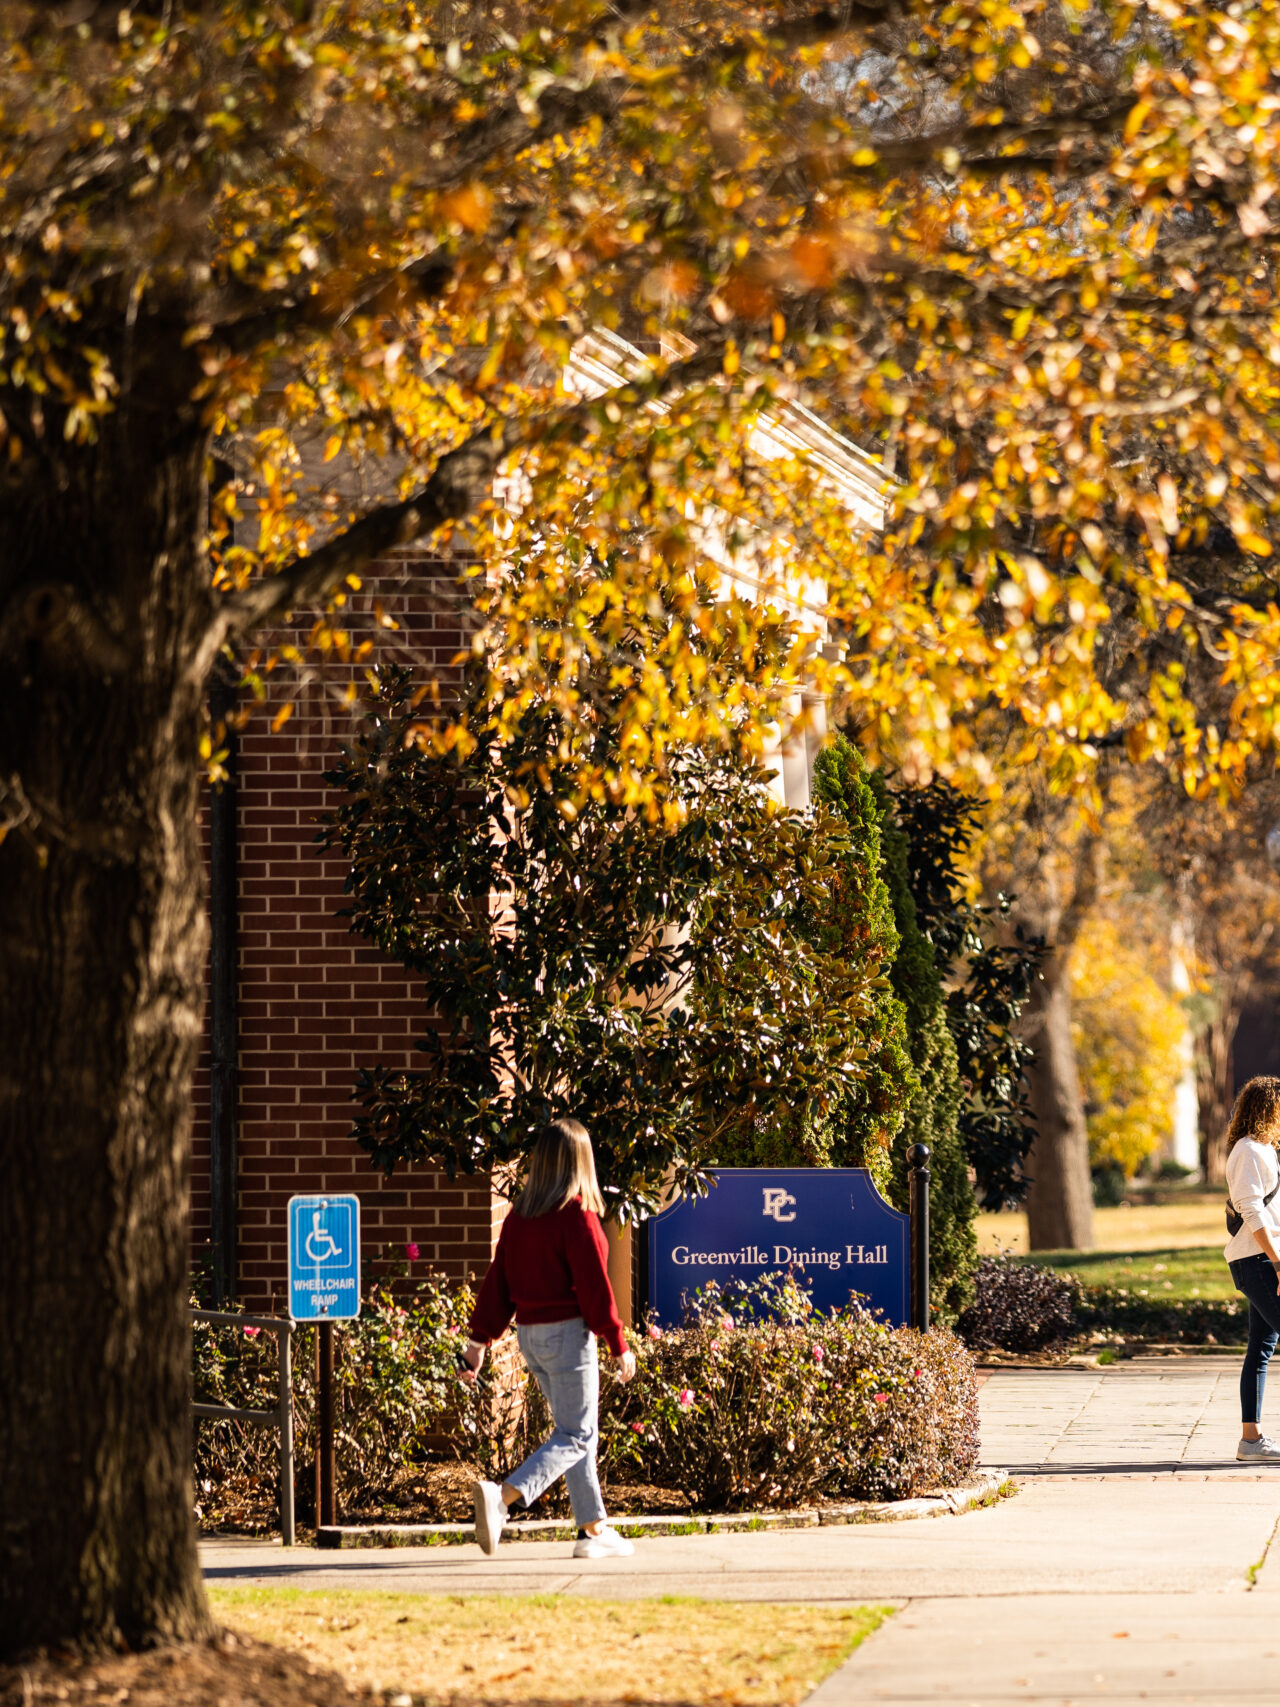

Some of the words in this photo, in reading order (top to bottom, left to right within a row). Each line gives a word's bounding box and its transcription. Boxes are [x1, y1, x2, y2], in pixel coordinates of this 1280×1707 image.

[671, 1245, 768, 1265] Greenville
[773, 1246, 841, 1270] Dining
[845, 1245, 888, 1264] Hall
[293, 1278, 355, 1292] WHEELCHAIR
[311, 1294, 338, 1306] RAMP
